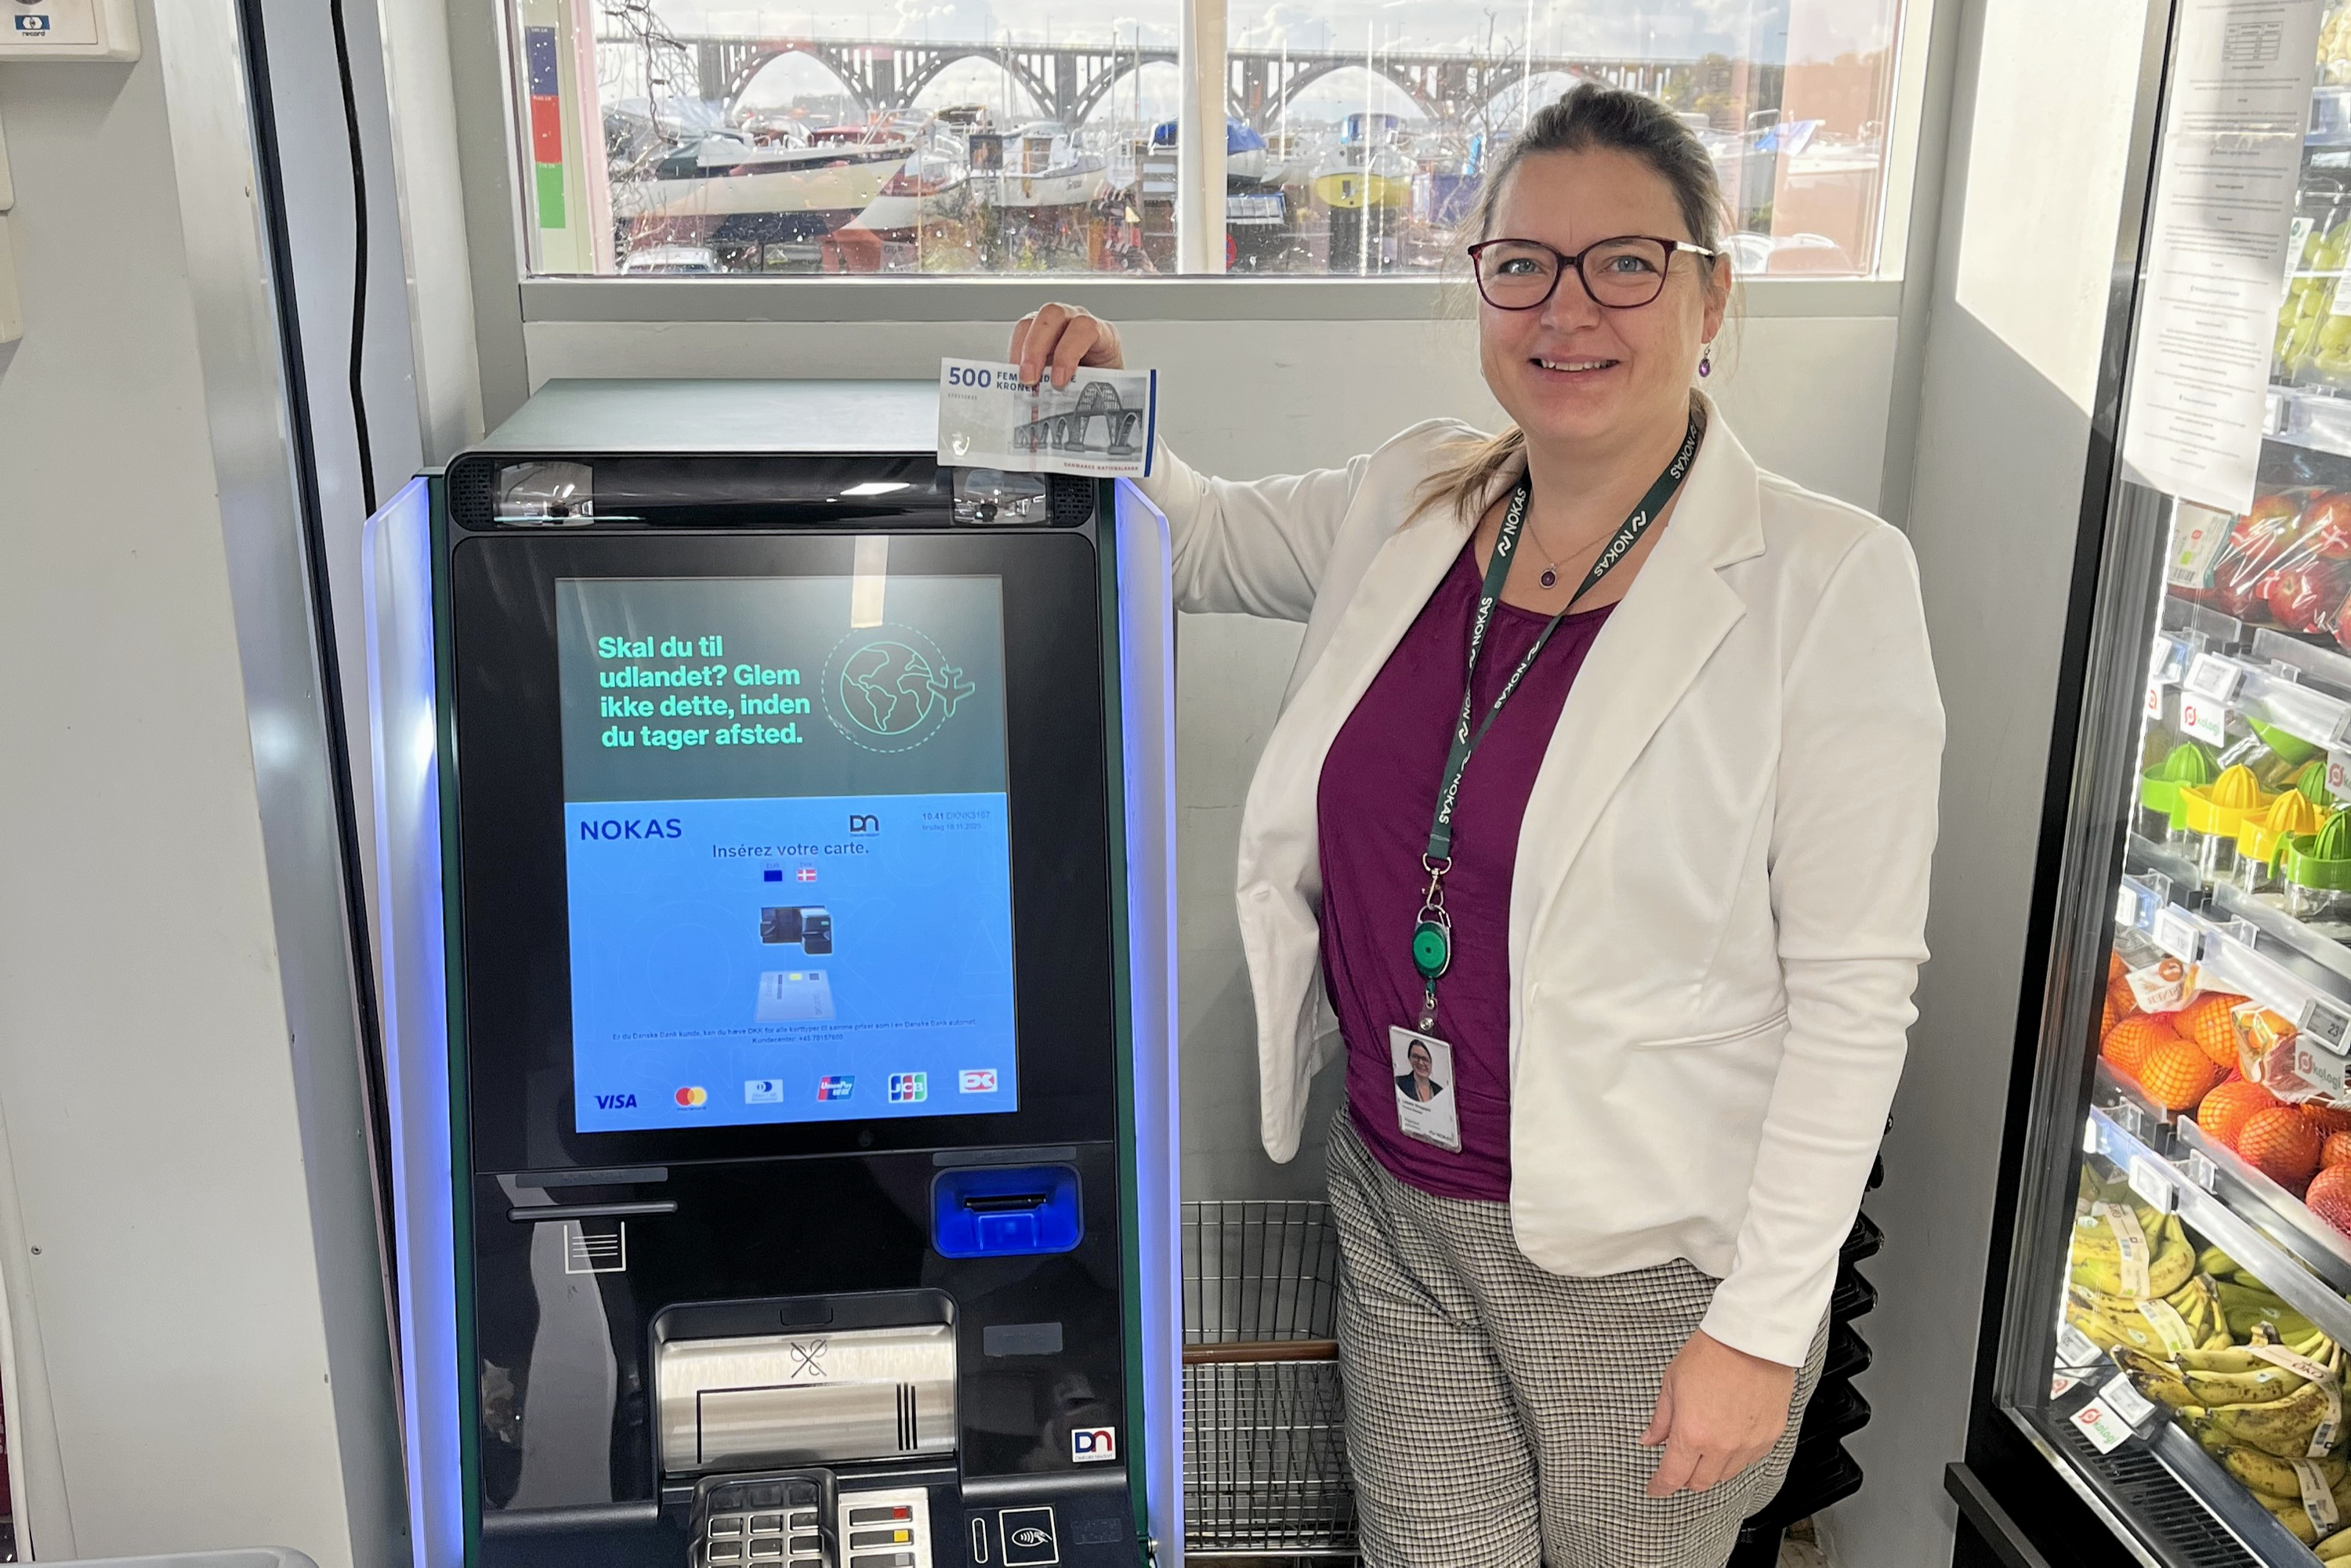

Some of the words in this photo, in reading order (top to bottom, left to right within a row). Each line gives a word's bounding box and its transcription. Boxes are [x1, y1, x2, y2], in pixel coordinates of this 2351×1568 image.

[948, 366, 991, 388] 500
[997, 371, 1017, 381] FEM
[996, 382, 1038, 392] KRONER
[1671, 436, 1695, 480] NOKAS
[1504, 487, 1527, 536] NOKAS
[1593, 530, 1635, 578] NOKAS
[1472, 596, 1493, 646] NOKAS
[598, 636, 654, 659] Skal
[661, 636, 692, 657] du
[697, 636, 723, 657] til
[600, 665, 727, 688] udlandet?
[734, 664, 800, 686] Glem
[1494, 662, 1527, 709] NOKAS
[600, 696, 654, 718] ikke
[660, 694, 735, 719] dette,
[741, 693, 810, 715] inden
[602, 726, 634, 747] du
[640, 725, 709, 750] tager
[715, 722, 803, 745] afsted.
[1438, 773, 1462, 824] NOKAS
[922, 812, 944, 820] 10.41
[581, 818, 682, 840] NOKAS
[712, 843, 772, 858] Insérez
[777, 843, 819, 856] votre
[824, 842, 869, 855] carte.
[891, 1082, 924, 1093] JCB
[593, 1094, 637, 1110] VISA
